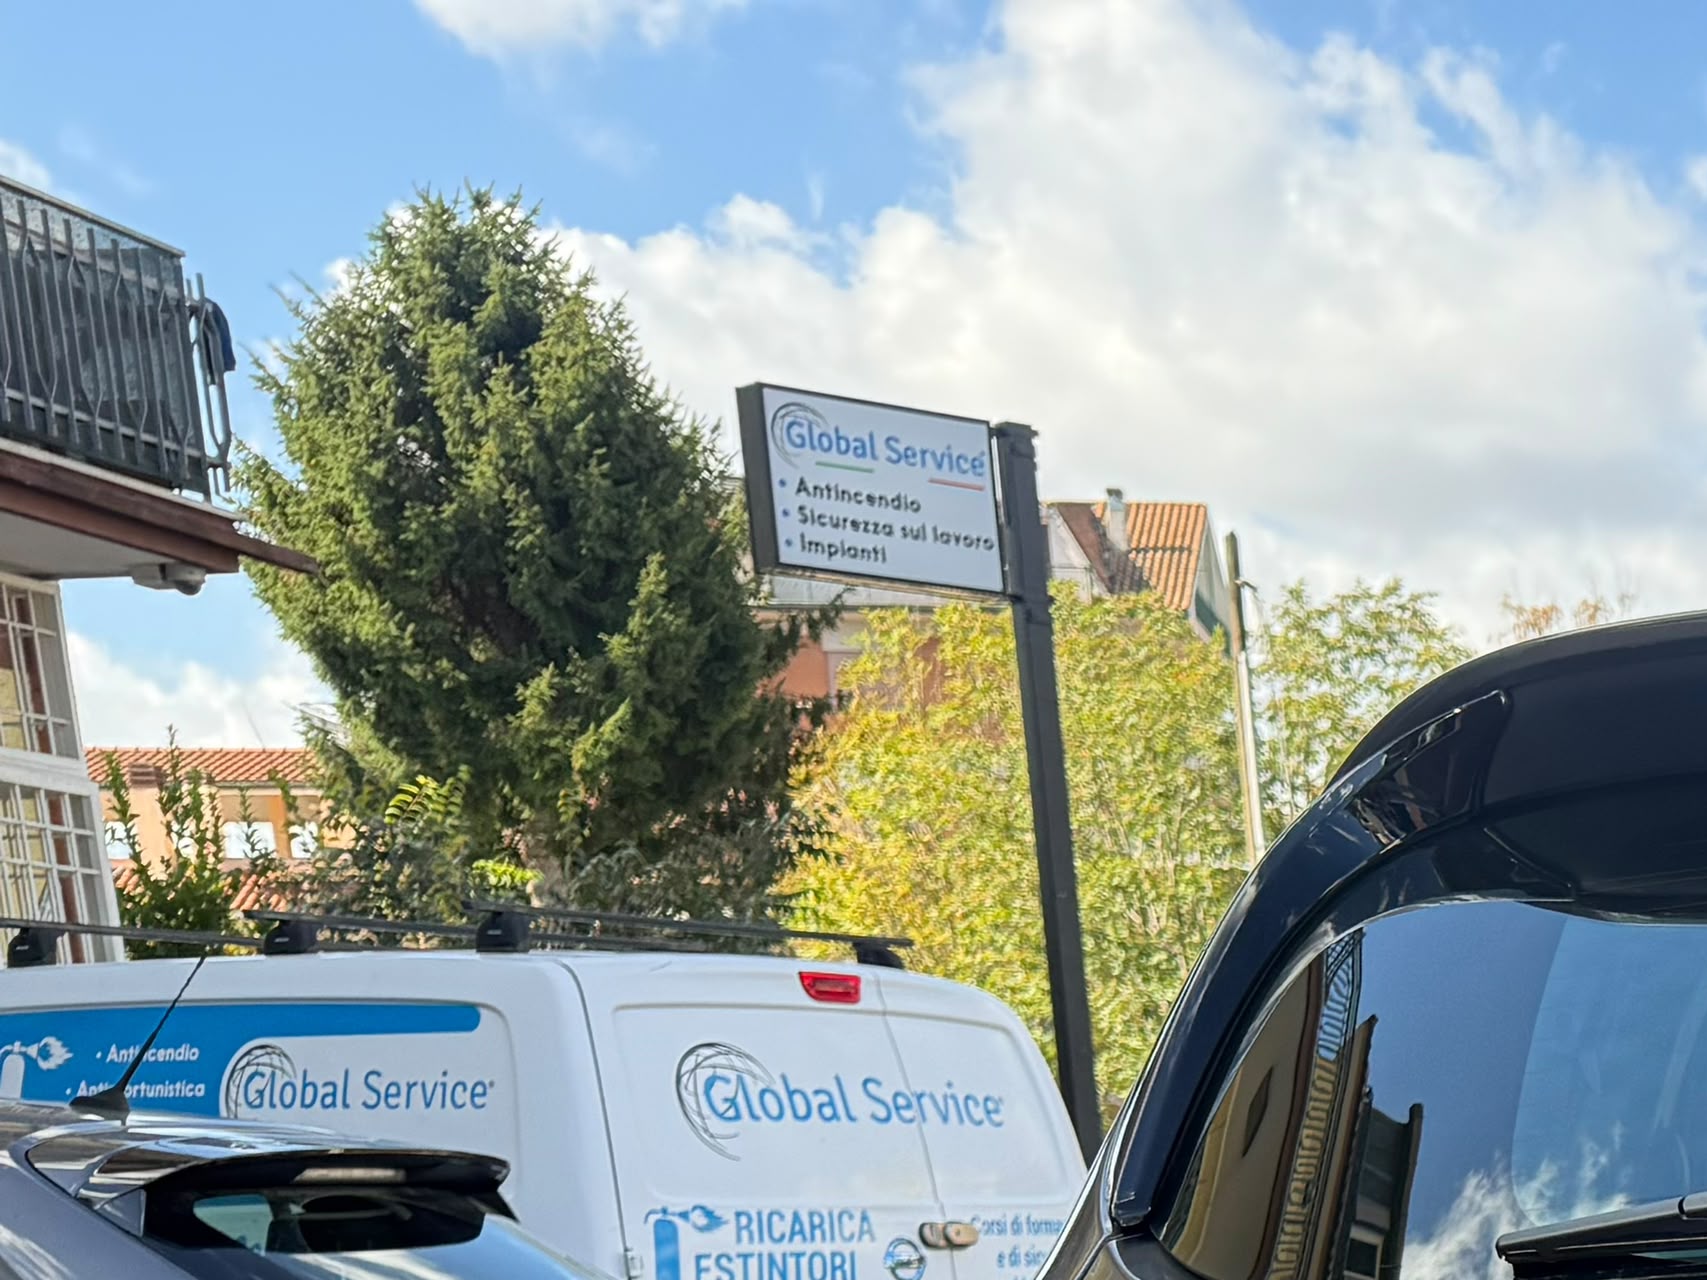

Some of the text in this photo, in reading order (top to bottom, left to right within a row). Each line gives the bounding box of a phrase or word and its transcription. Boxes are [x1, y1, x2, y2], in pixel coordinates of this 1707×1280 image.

[786, 420, 985, 477] Global Service
[795, 477, 922, 513] Antincendio
[798, 507, 995, 551] Sicurezza sul lavoro
[800, 534, 887, 563] Impianti
[106, 1043, 199, 1063] Anticendio
[76, 1079, 206, 1099] Antiortunistica
[243, 1067, 488, 1110] Global Service
[703, 1073, 1003, 1127] Global Service
[734, 1208, 876, 1246] RICARICA
[1026, 1213, 1064, 1236] forma
